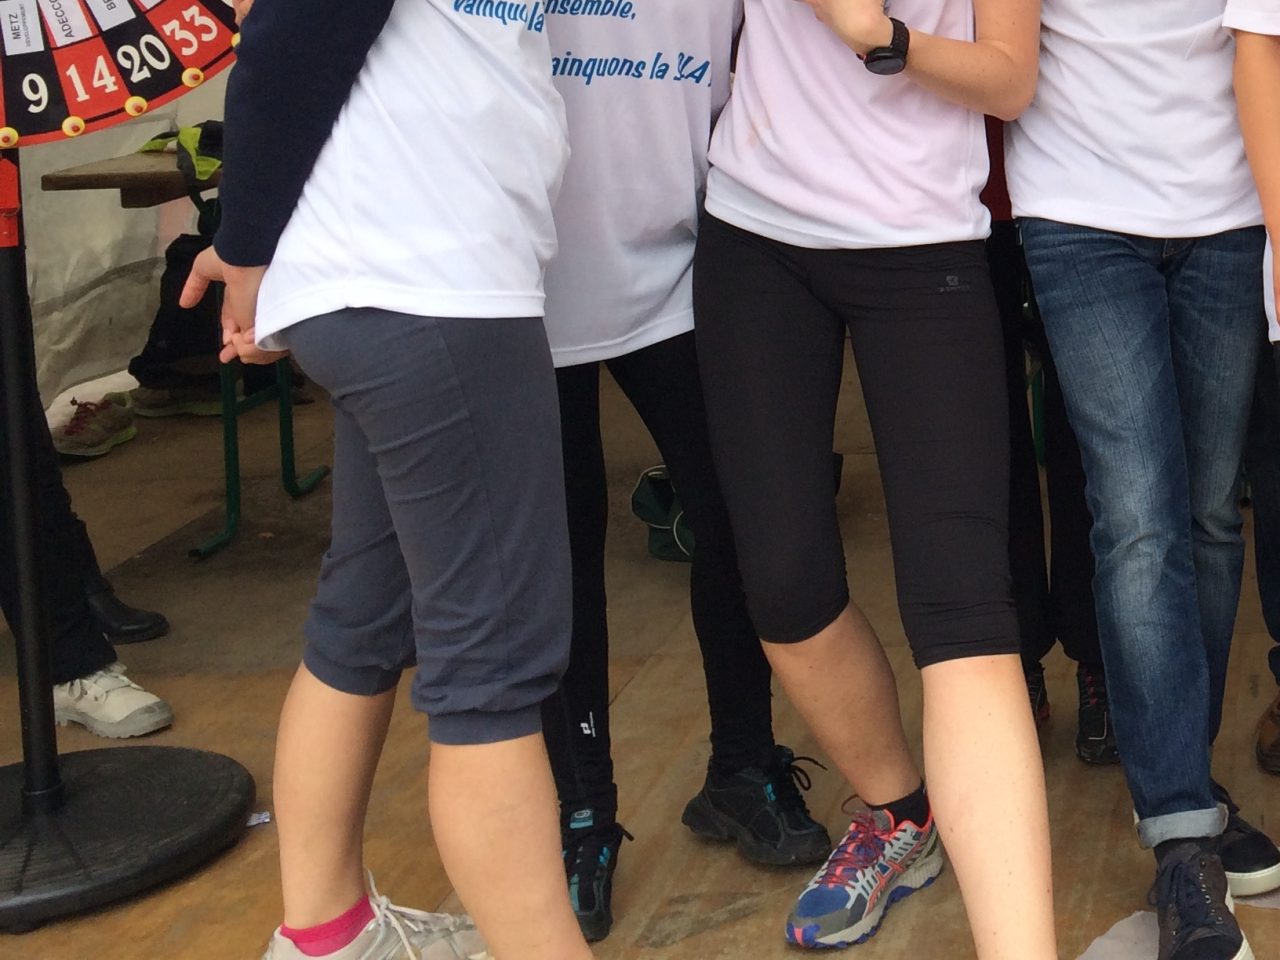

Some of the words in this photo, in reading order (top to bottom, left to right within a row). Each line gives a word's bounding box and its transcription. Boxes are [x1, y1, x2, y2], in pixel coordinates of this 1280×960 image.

[8, 13, 22, 40] METZ
[162, 4, 218, 56] 33
[66, 55, 119, 102] 14
[117, 34, 171, 84] 20
[649, 52, 670, 81] la
[22, 72, 49, 114] 9
